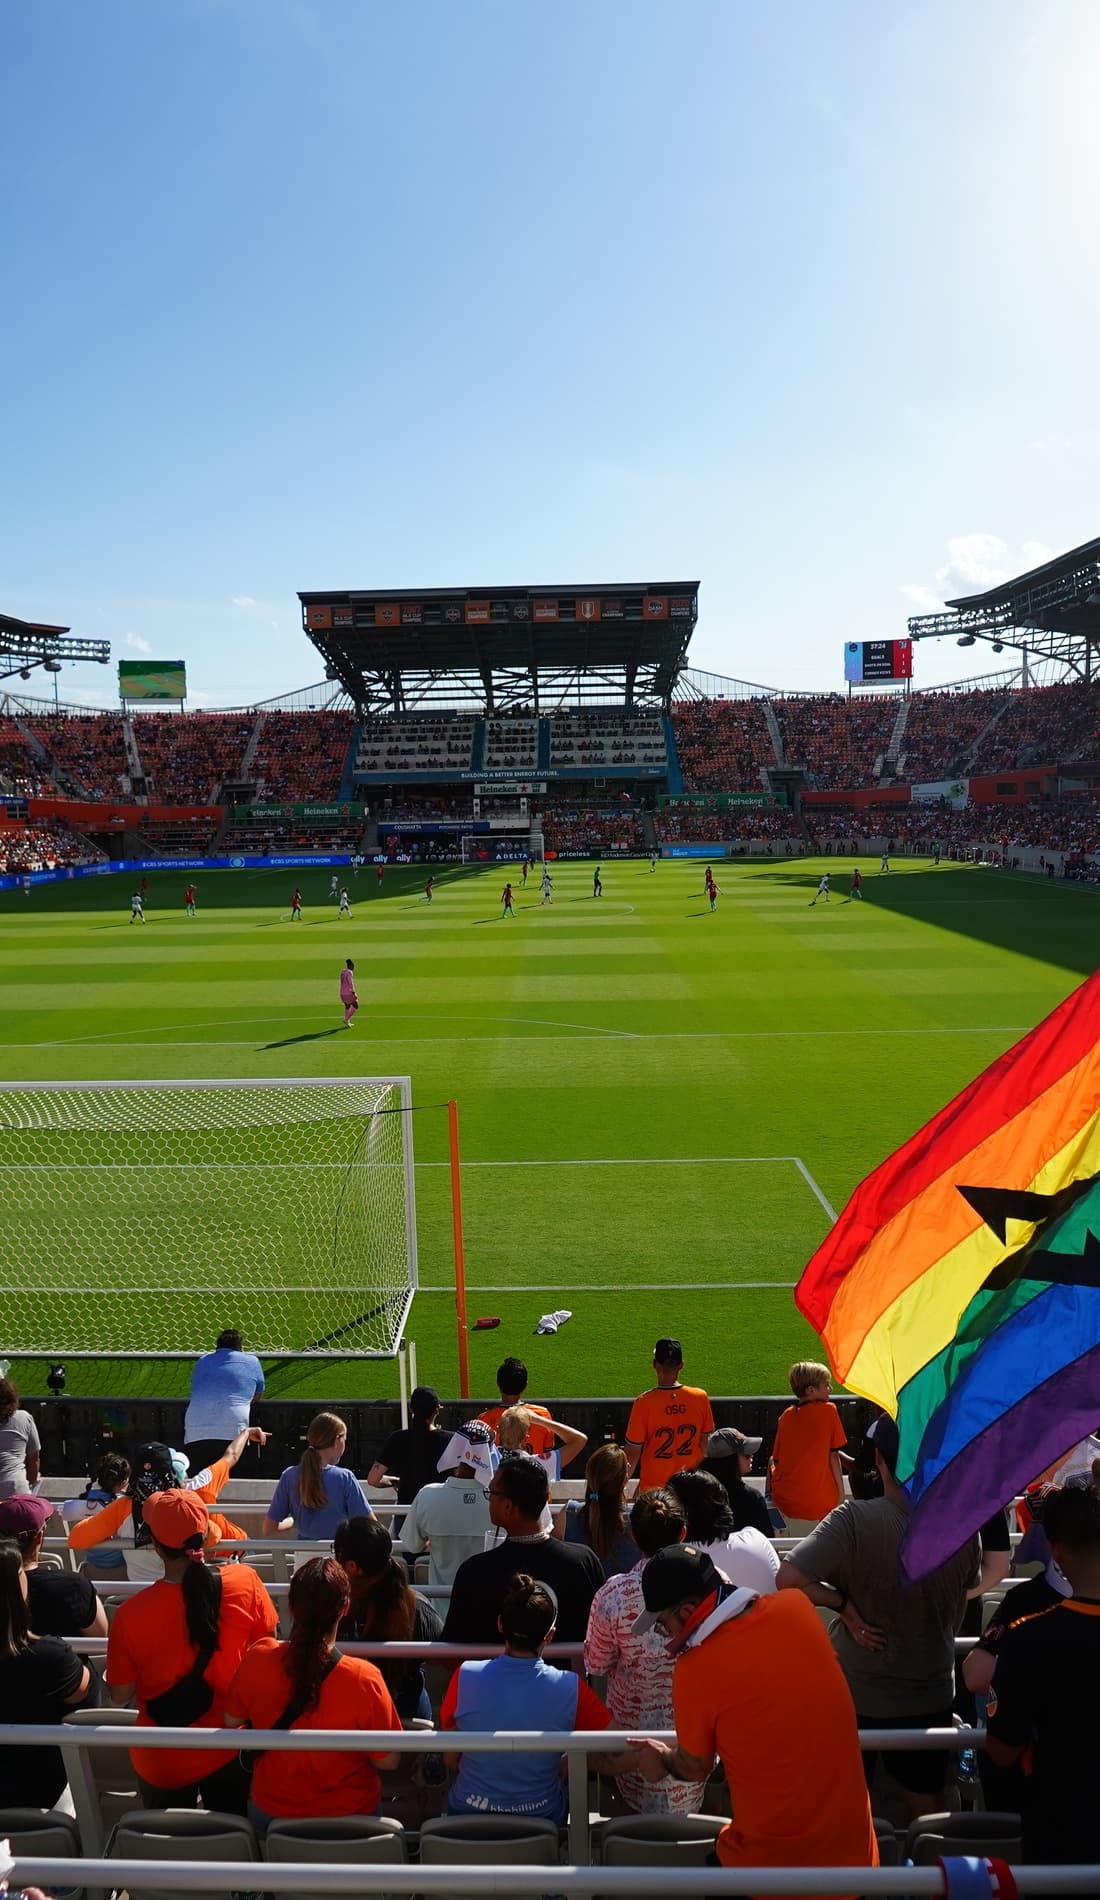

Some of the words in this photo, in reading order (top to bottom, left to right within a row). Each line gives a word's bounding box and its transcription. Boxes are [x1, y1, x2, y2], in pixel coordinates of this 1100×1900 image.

[480, 785, 518, 793] Heineken
[728, 798, 763, 806] Heineken
[396, 854, 411, 863] ally
[559, 850, 590, 858] priceless
[373, 854, 388, 864] ally
[665, 1404, 687, 1415] OSG
[654, 1424, 697, 1459] 22
